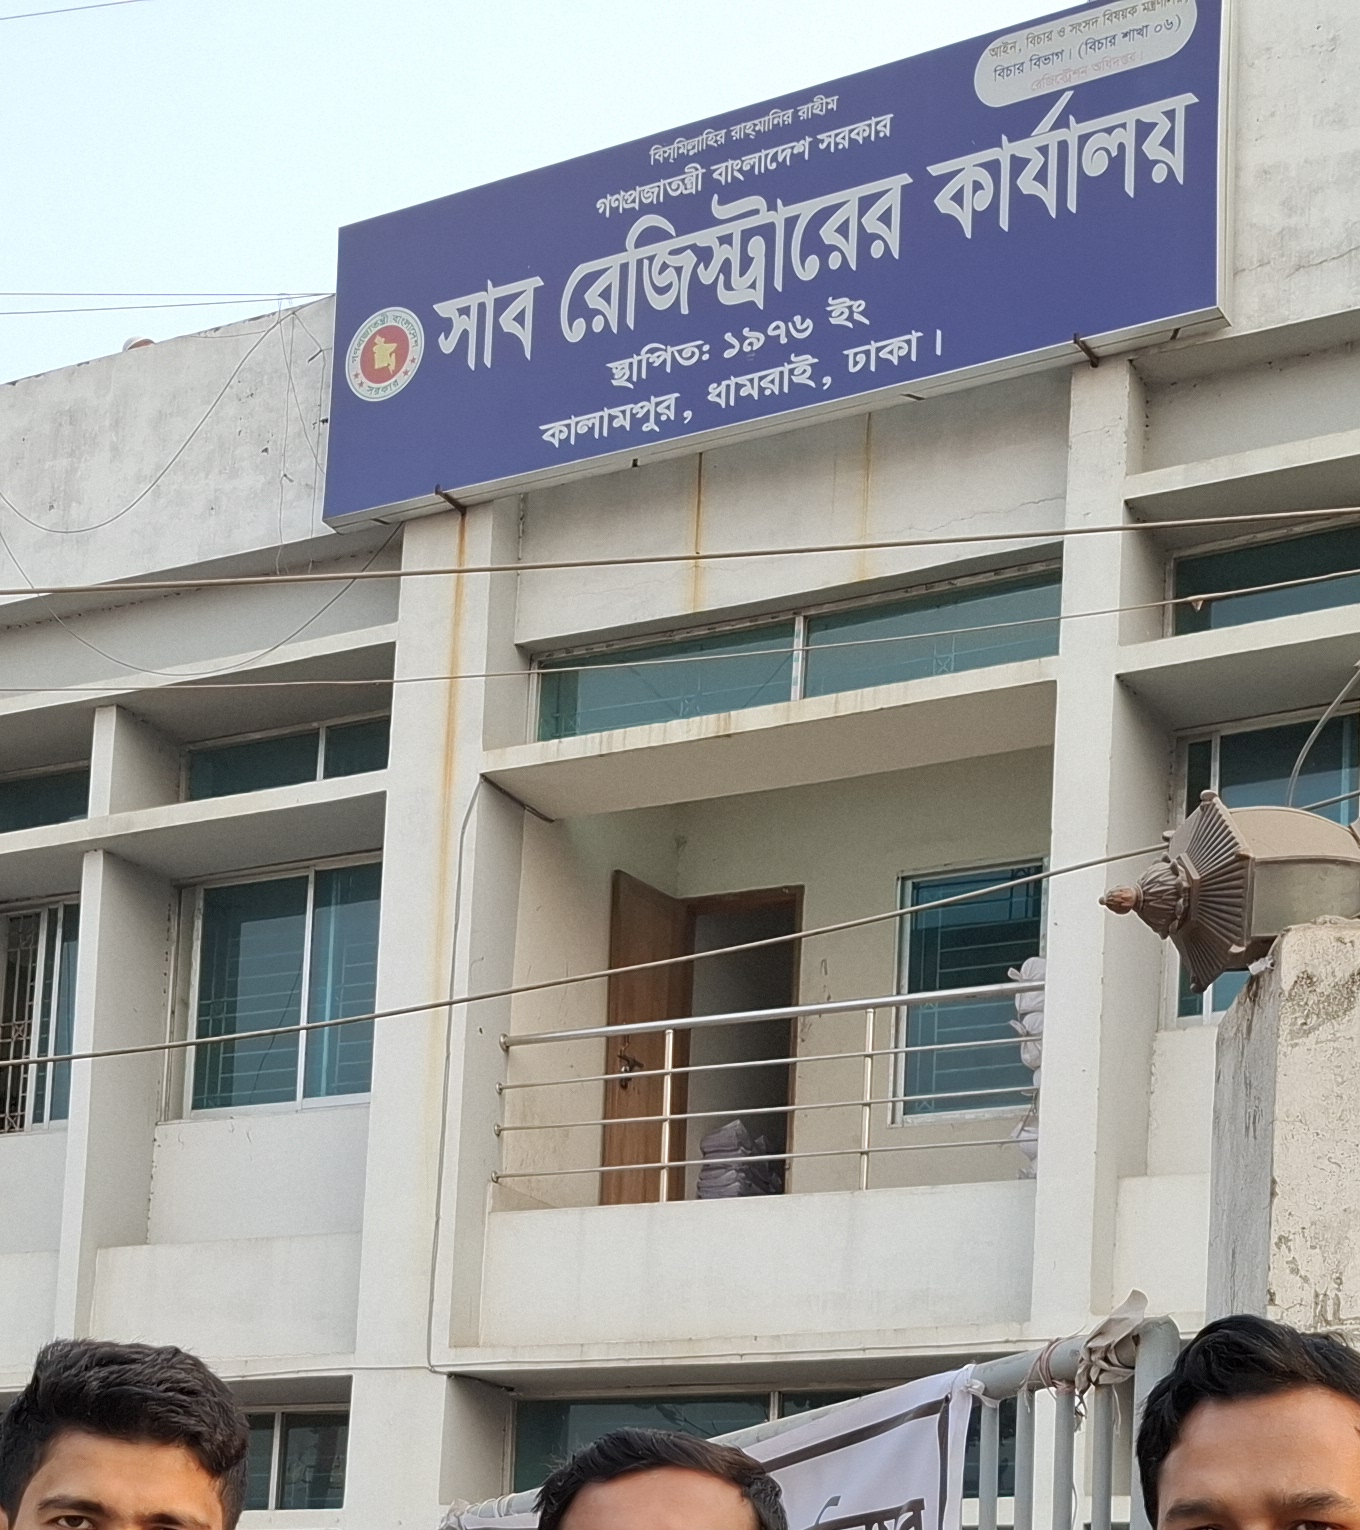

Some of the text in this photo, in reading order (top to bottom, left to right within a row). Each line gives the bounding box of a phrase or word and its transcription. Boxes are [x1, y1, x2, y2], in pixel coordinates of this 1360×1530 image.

[993, 61, 1025, 82] বিচার
[1121, 23, 1150, 43] শাখা
[1026, 32, 1053, 50] বিচার
[1068, 16, 1099, 35] সংসদ
[798, 94, 839, 121] রাহীম
[596, 113, 894, 218] গণপ্রজাতন্ত্রী বাংলাদেশ সরকার
[433, 90, 1200, 371] সাব রেজিস্ট্রারের কার্যালয়
[723, 314, 813, 358] ১৯৭৬
[825, 297, 870, 329] ইং
